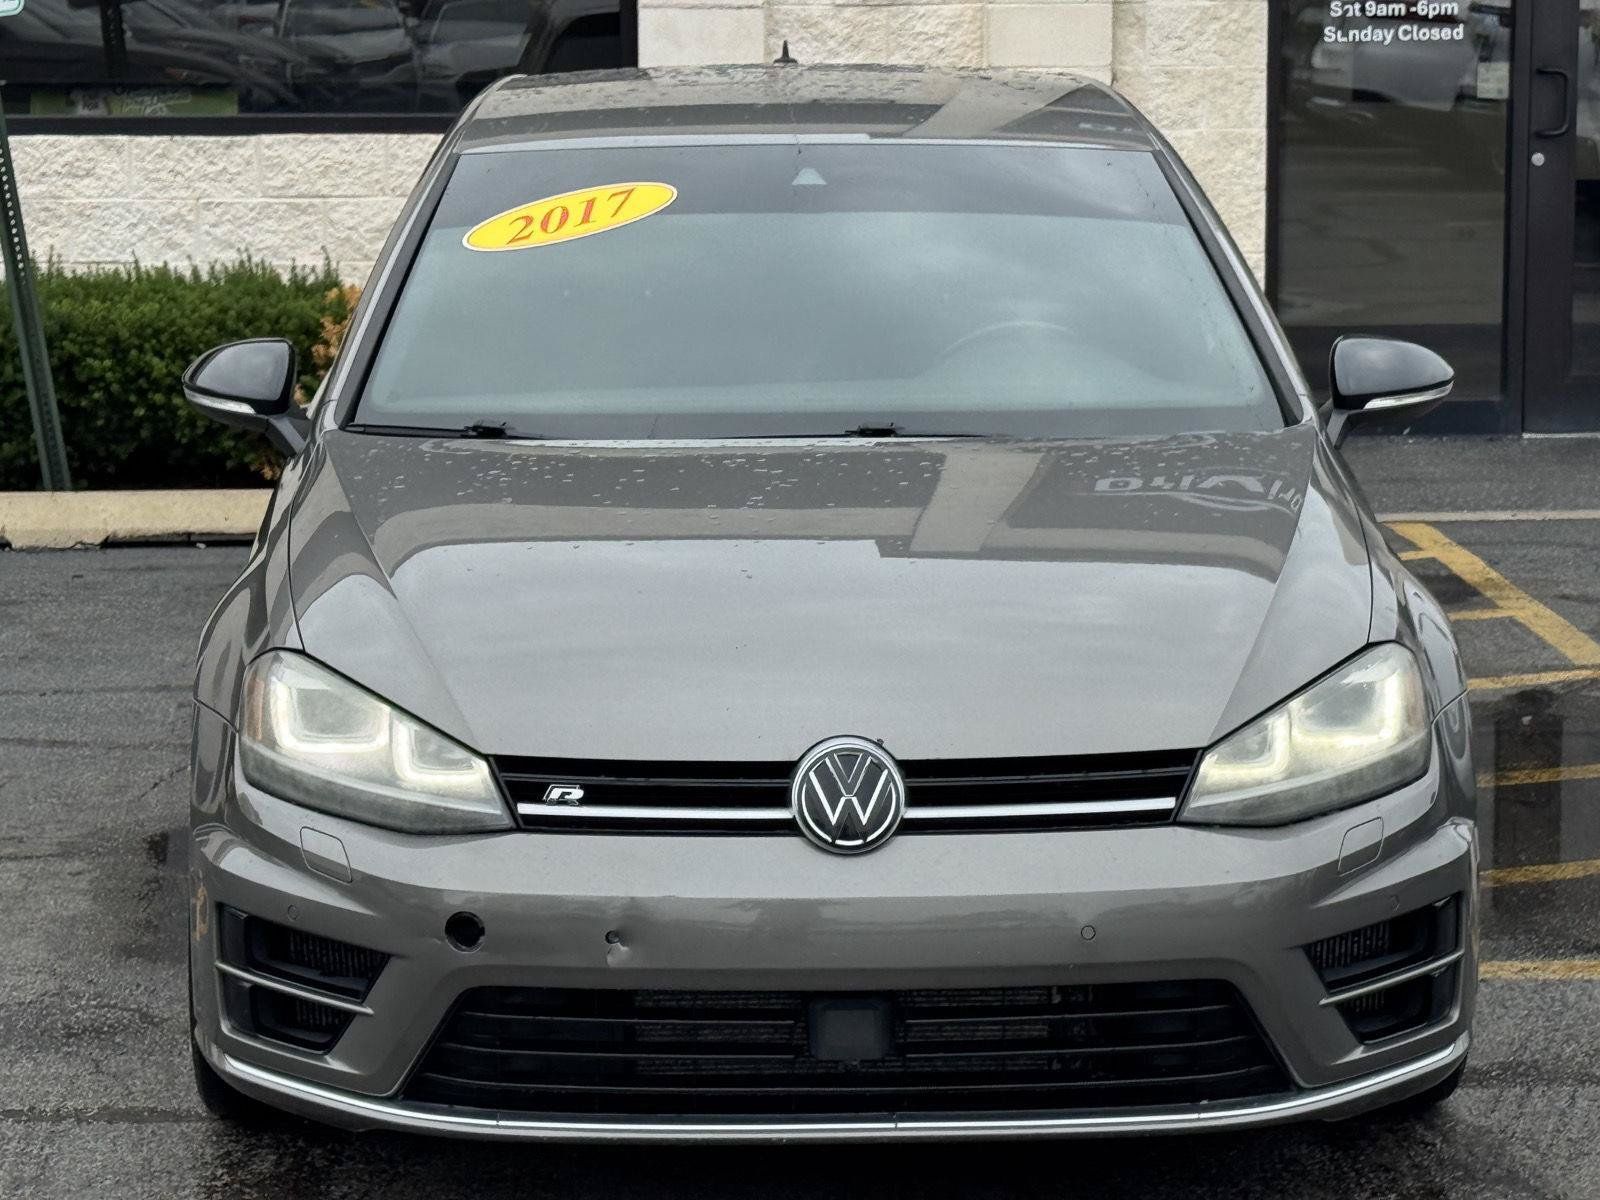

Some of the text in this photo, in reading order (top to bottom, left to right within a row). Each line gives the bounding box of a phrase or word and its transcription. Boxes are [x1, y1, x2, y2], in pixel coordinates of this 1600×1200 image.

[1364, 1, 1406, 17] 9am
[1397, 23, 1465, 41] Closed
[505, 187, 637, 245] 2017
[543, 784, 585, 806] R
